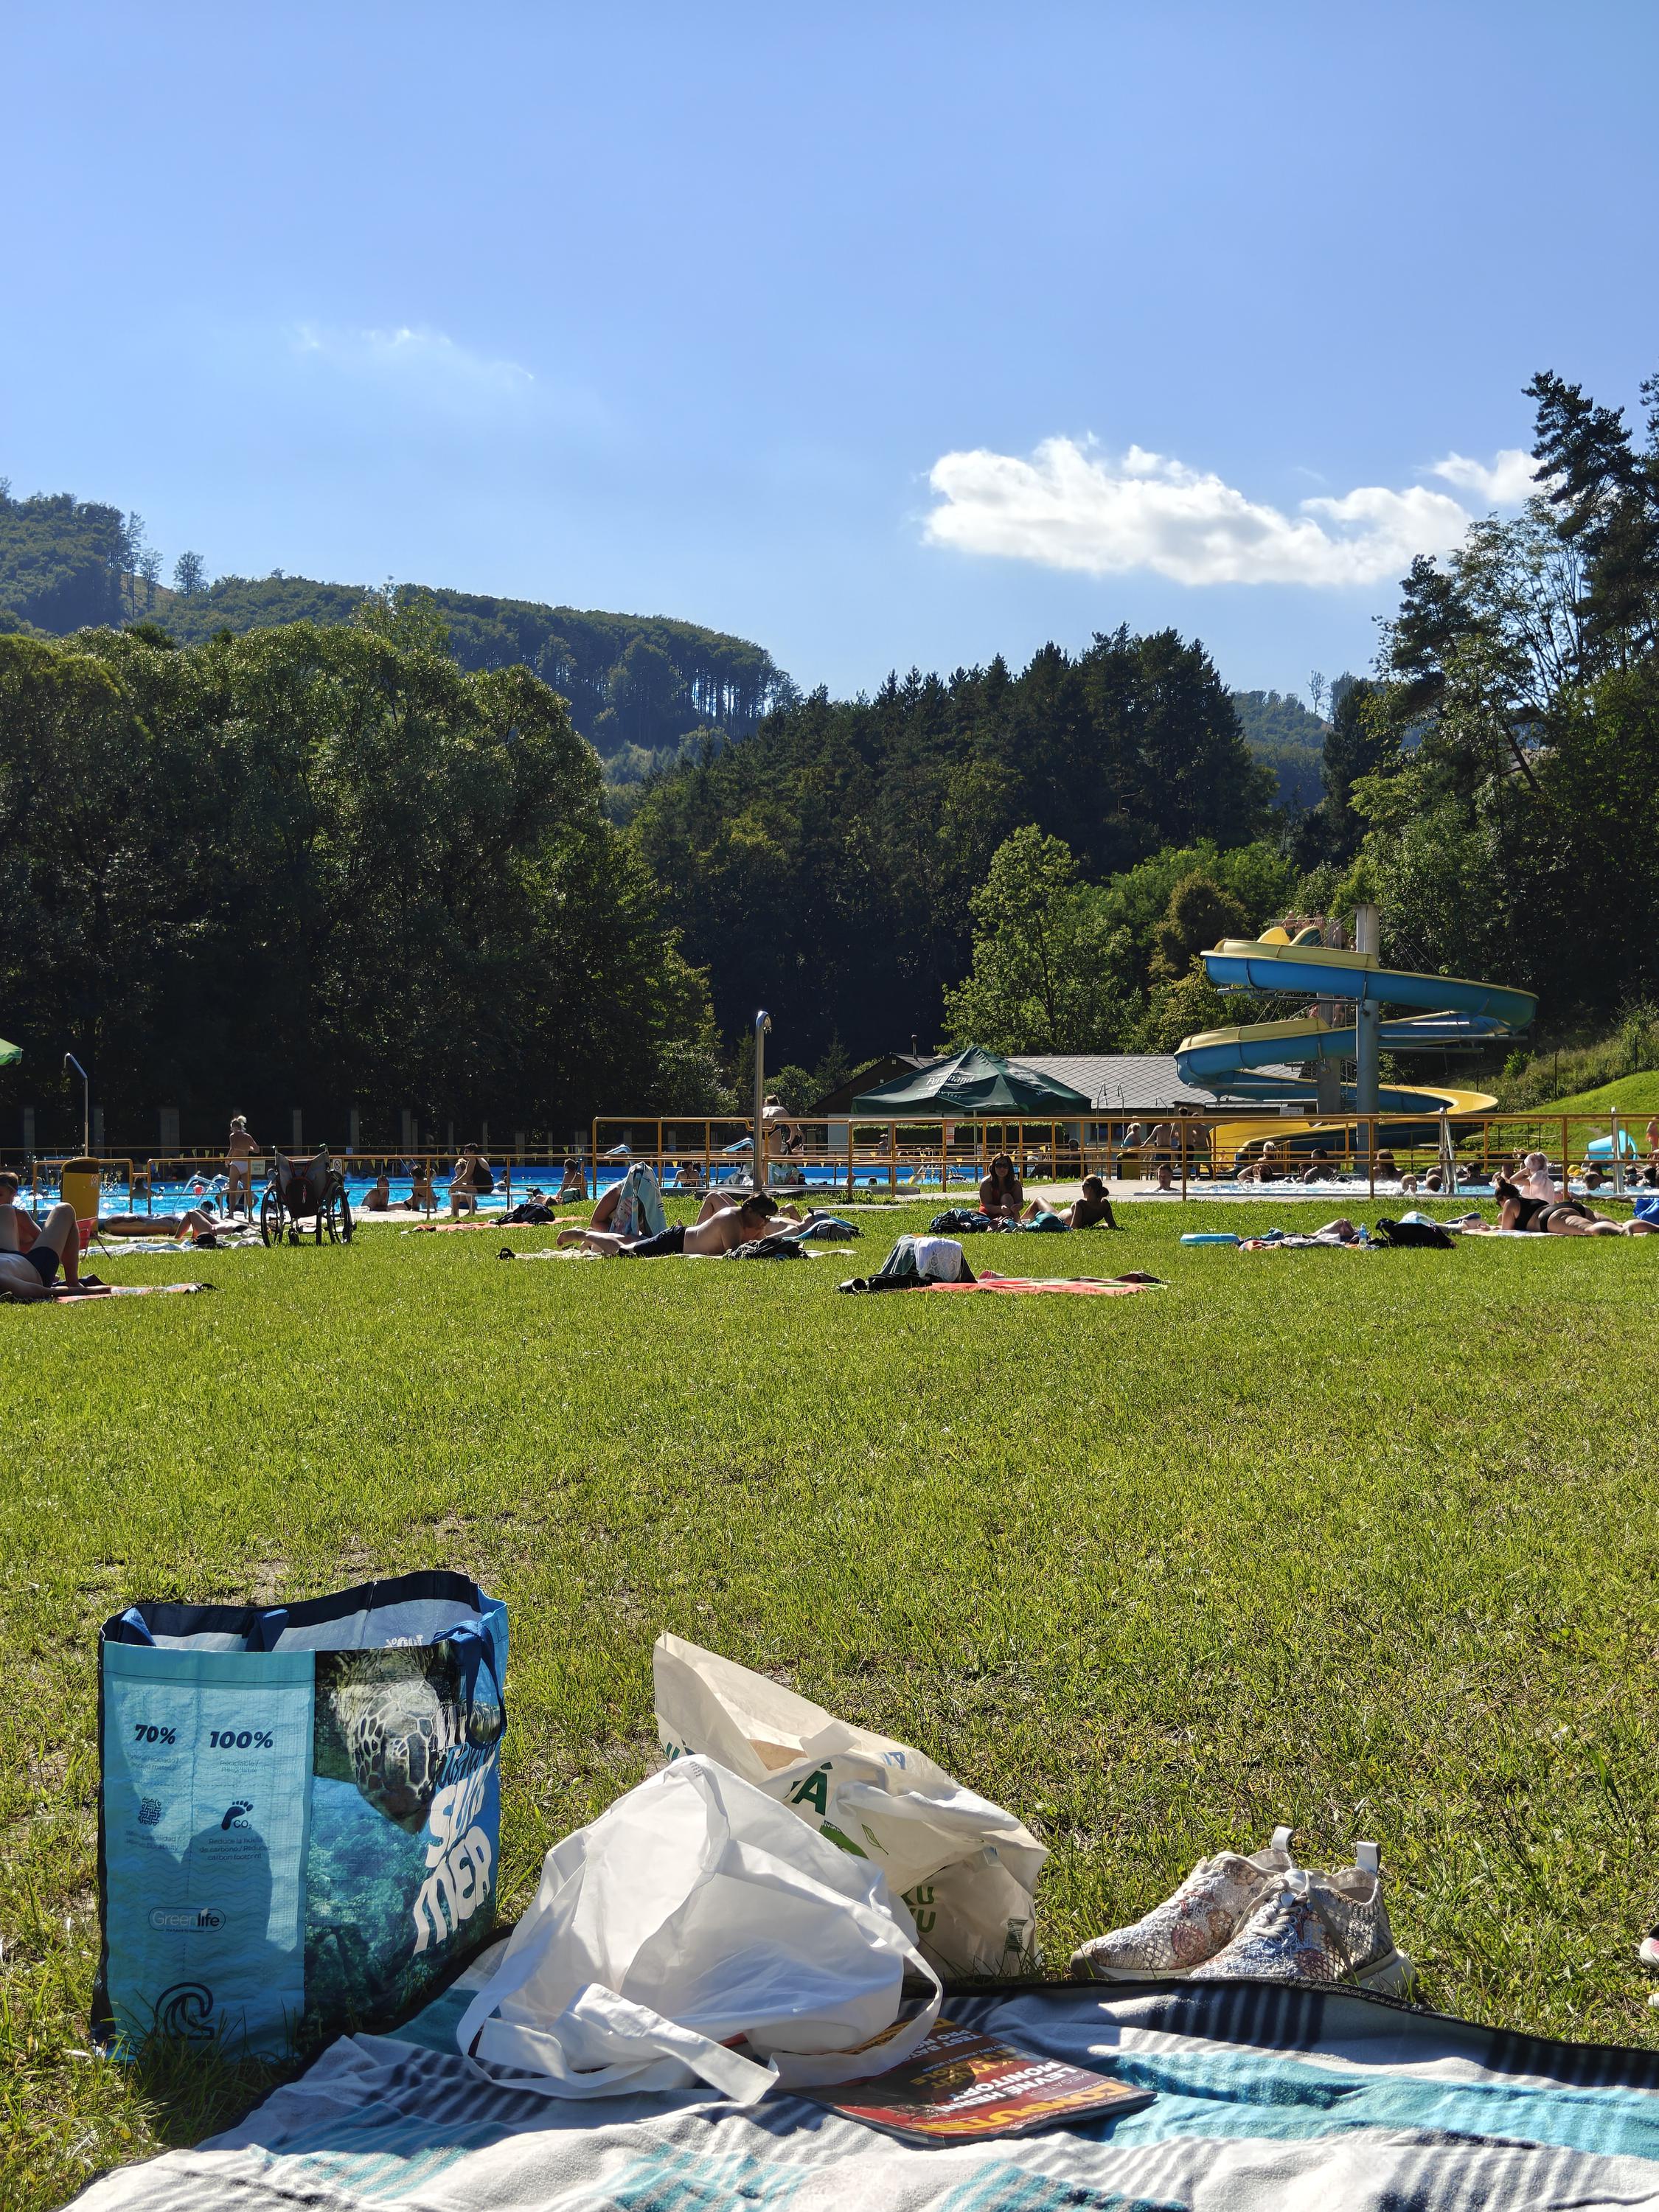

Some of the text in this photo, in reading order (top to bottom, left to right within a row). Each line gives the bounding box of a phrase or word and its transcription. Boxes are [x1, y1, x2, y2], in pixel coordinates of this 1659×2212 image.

[926, 1074, 974, 1085] Ferdnand
[135, 1724, 177, 1745] 70%
[210, 1731, 274, 1749] 100%
[785, 1761, 833, 1816] Á
[413, 1826, 492, 1958] MER
[909, 1907, 936, 1933] U
[916, 2029, 972, 2049] PRO NO
[944, 2034, 984, 2048] TEST
[949, 2061, 1062, 2102] MONITORY
[1002, 2067, 1078, 2095] LEVNÉ
[1026, 2072, 1091, 2096] MEGATEST
[913, 2081, 1133, 2131] COMPUTER
